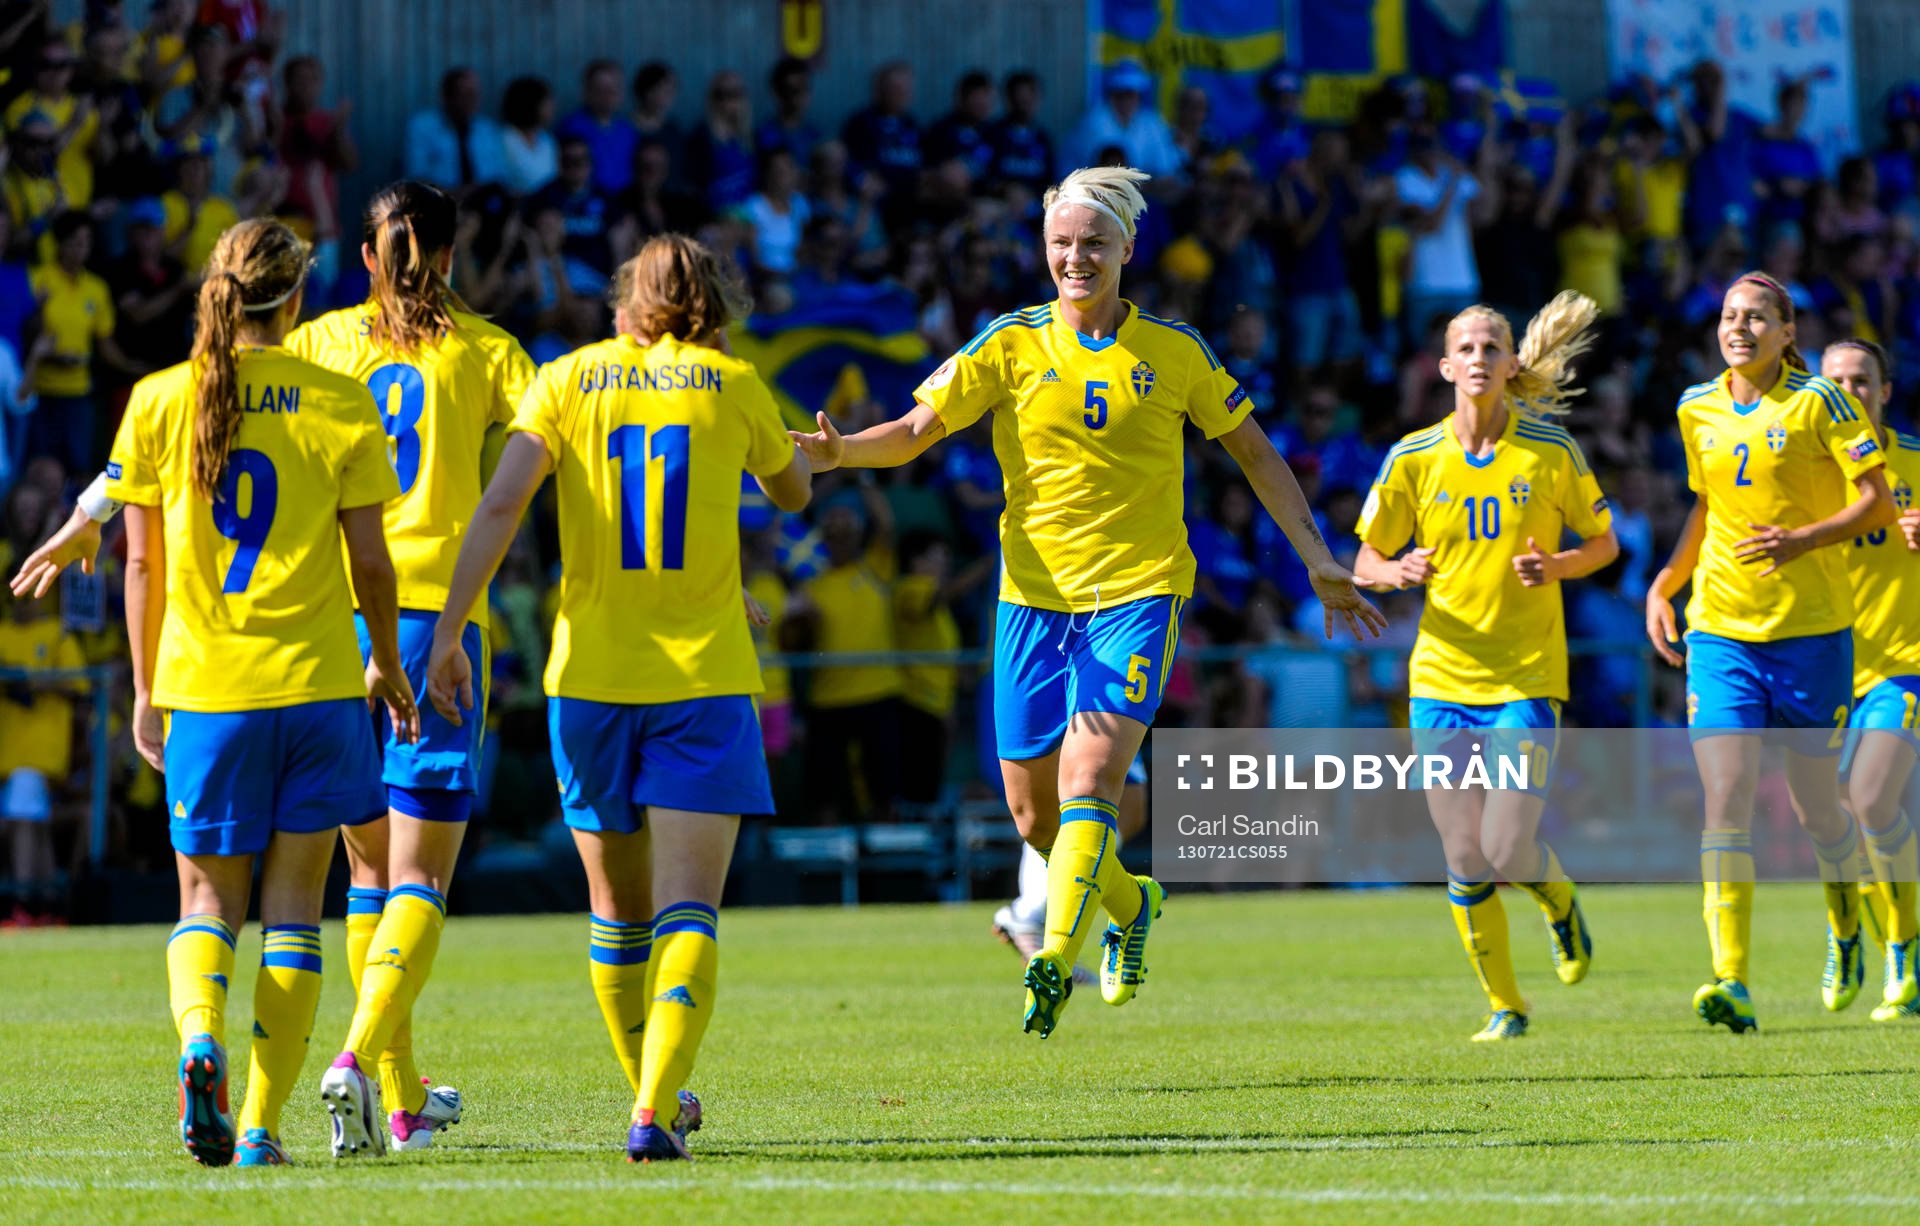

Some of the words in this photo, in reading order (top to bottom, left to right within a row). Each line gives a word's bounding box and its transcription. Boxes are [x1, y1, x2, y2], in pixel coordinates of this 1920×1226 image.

[240, 384, 300, 414] LANI
[580, 362, 722, 394] GÖRANSSON
[1083, 381, 1109, 430] 5
[1733, 443, 1752, 486] 2
[607, 424, 690, 570] 11
[1464, 496, 1500, 541] 10
[211, 448, 278, 594] 9
[1125, 654, 1151, 703] 5
[1827, 705, 1848, 748] 2
[1121, 921, 1150, 985] PUMA
